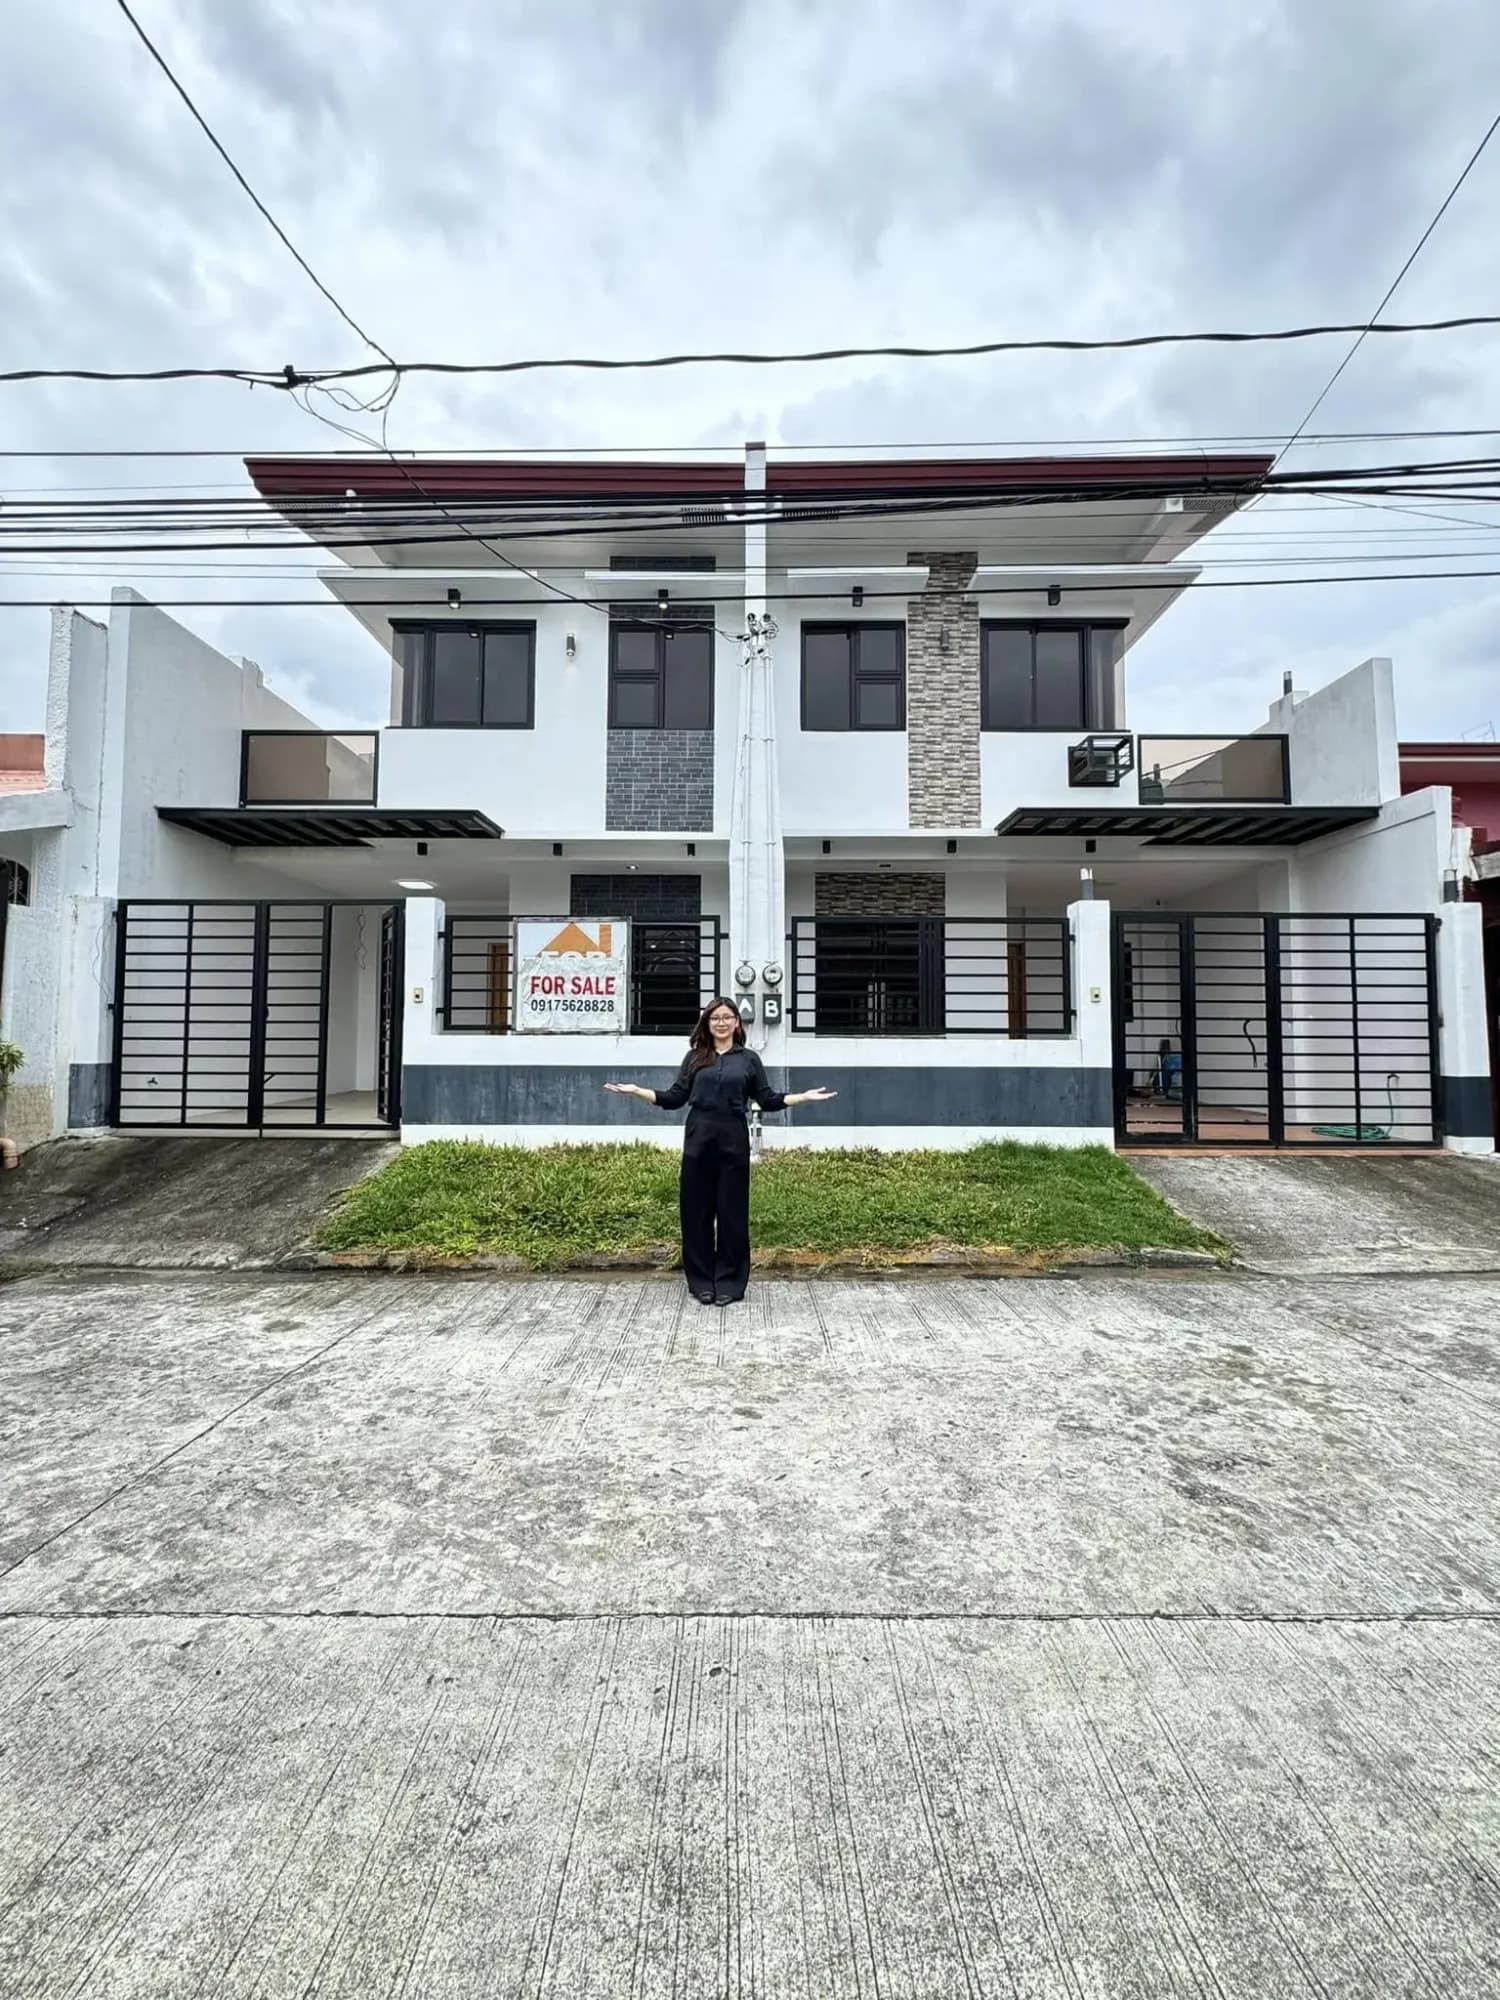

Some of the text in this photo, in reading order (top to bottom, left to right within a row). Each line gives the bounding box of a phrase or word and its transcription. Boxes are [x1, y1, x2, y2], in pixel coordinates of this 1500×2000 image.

[530, 976, 616, 995] FOR SALE
[530, 999, 615, 1012] 09175628828
[739, 998, 752, 1013] A
[765, 1000, 779, 1017] B
